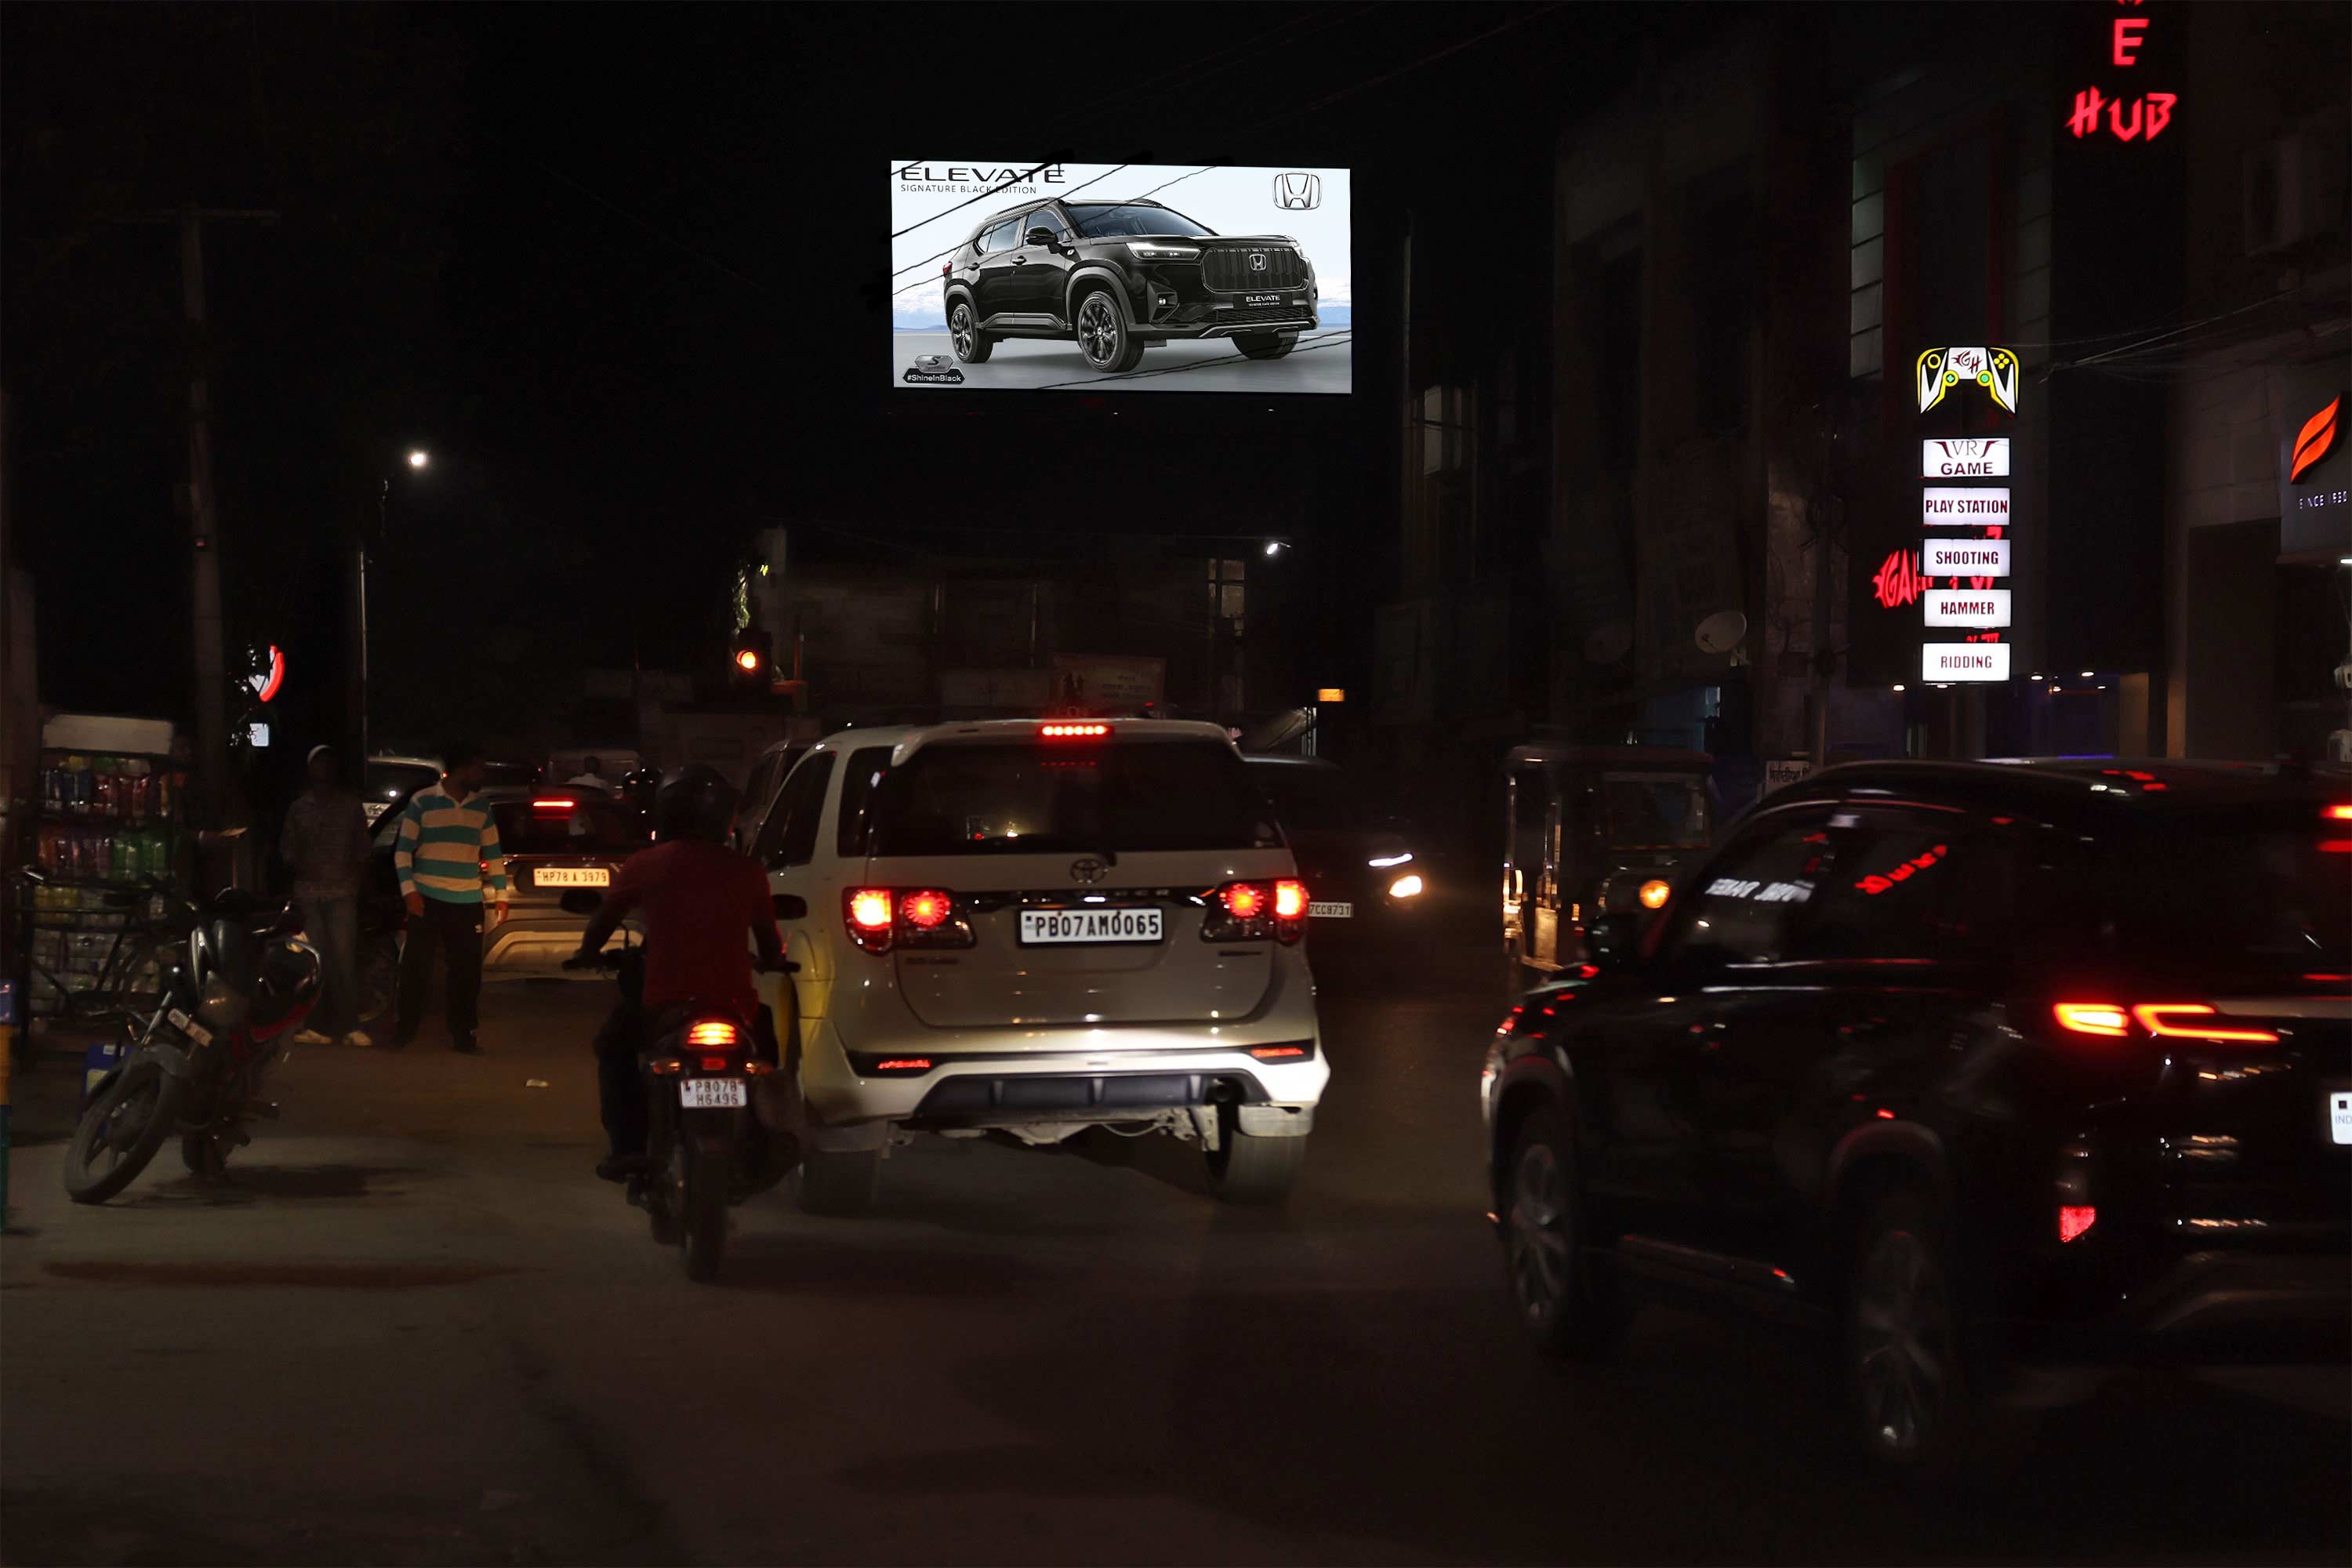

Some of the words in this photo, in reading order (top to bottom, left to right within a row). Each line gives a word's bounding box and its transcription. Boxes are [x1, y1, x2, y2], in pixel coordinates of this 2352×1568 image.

[2064, 85, 2178, 142] HUB
[902, 167, 1065, 183] ELEVATE
[901, 184, 956, 193] SIGNATURE
[960, 185, 992, 194] BLACK
[1951, 441, 1977, 455] VR
[1940, 462, 1994, 475] GAME
[1926, 499, 1954, 514] PLAY
[1958, 499, 2009, 514] STATION
[1936, 551, 1999, 564] SHOOTING
[1940, 602, 1995, 615] HAMMER
[1940, 655, 1993, 669] RIDDING
[1036, 915, 1159, 937] PB07AM0065
